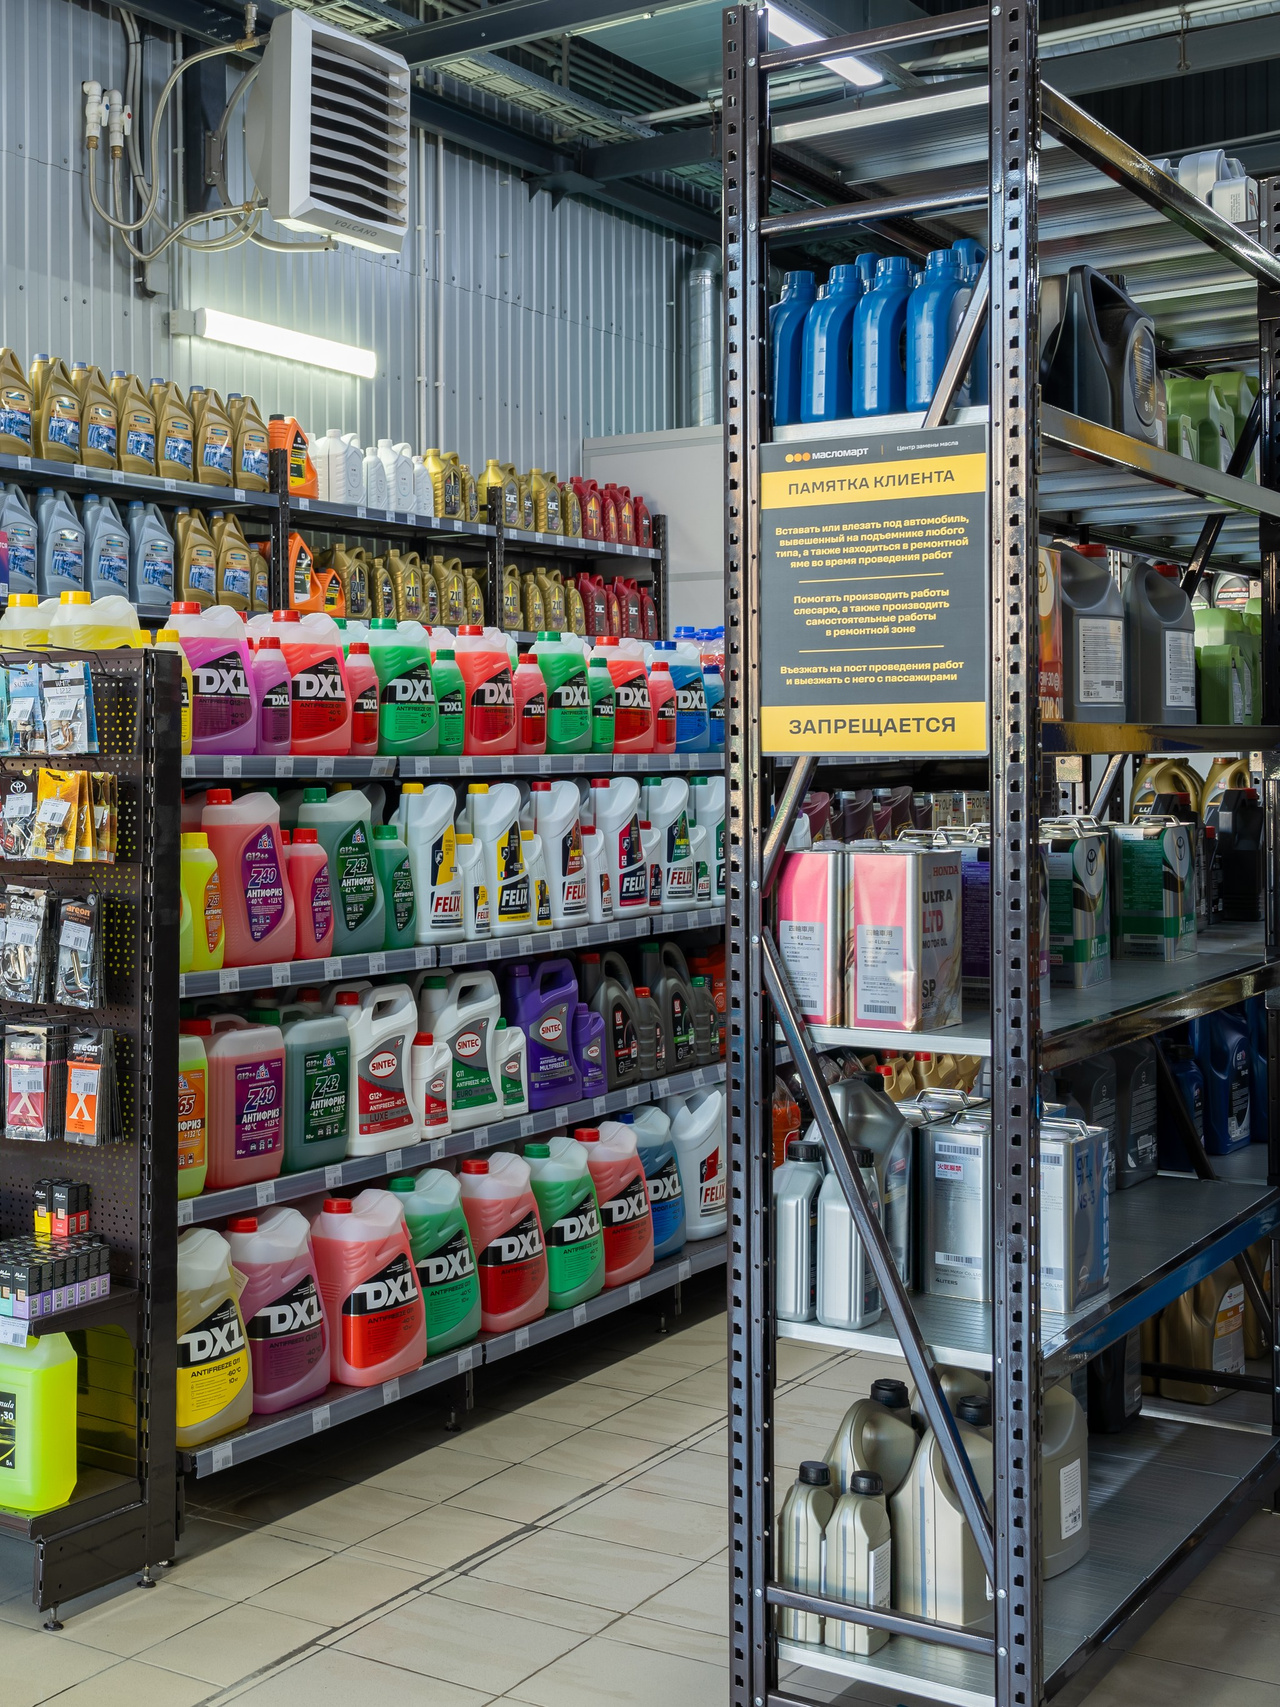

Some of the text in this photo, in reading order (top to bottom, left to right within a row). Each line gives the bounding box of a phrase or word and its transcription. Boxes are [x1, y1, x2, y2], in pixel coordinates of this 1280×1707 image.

[813, 447, 869, 460] масломарт
[897, 444, 915, 452] Центр
[789, 470, 955, 495] ПАМЯТКА КЛИЕНТА
[506, 494, 517, 502] ZIC
[776, 527, 820, 535] Вставать
[843, 522, 881, 531] влезать
[884, 520, 902, 529] под
[904, 515, 969, 525] автомобиль,
[780, 535, 845, 545] вывешенный
[861, 530, 924, 541] подъемнике
[925, 527, 964, 537] любого
[811, 547, 841, 555] также
[843, 543, 901, 553] находиться
[910, 537, 968, 550] ремонтной
[825, 558, 856, 567] время
[859, 554, 920, 565] проведения
[922, 551, 952, 561] работ
[794, 589, 949, 603] Помогать производить работы
[595, 605, 604, 613] ZIC
[794, 607, 840, 615] слесарю,
[850, 604, 880, 612] также
[882, 601, 949, 611] производить
[806, 612, 936, 625] самостоятельные работы
[834, 625, 889, 637] ремонтной
[780, 666, 828, 674] Въезжать
[869, 663, 930, 673] проведения
[933, 660, 964, 671] работ
[196, 668, 251, 694] DX1
[296, 674, 345, 698] DX1
[795, 677, 843, 685] выезжать
[885, 673, 957, 683] пассажирами
[394, 679, 435, 701] DX1
[484, 683, 514, 704] DX1
[559, 685, 589, 706] DX1
[619, 687, 651, 707] DX1
[790, 717, 955, 736] ЗАПРЕЩАЕТСЯ
[671, 870, 693, 886] FELIX
[933, 866, 959, 877] HONDA
[341, 876, 374, 887] АНТИФРИЗ
[622, 873, 645, 893] FELIX
[247, 888, 283, 898] АНТИФРИЗ
[501, 886, 528, 906] FELIX
[922, 889, 953, 903] ULTRA
[66, 905, 90, 914] areon
[434, 895, 461, 913] FELIX
[922, 911, 944, 933] LTD
[922, 938, 948, 949] MOTOR OIL
[922, 979, 936, 997] SP
[541, 1022, 562, 1035] SINTEC
[73, 1043, 97, 1054] areon
[457, 1039, 480, 1050] SINTEC
[371, 1058, 395, 1072] SINTEC
[540, 1060, 565, 1072] MULTIFREEZE
[456, 1088, 474, 1099] EURO
[310, 1095, 346, 1111] АНТИФРИЗ
[242, 1108, 280, 1124] АНТИФРИЗ
[369, 1111, 389, 1123] LUXE
[562, 1213, 600, 1242] DX1
[498, 1231, 543, 1262] DX1
[426, 1251, 475, 1283] DX1
[364, 1272, 418, 1311] DX1
[430, 1284, 463, 1297] ANTIFREEZE
[266, 1297, 323, 1334] DX1
[187, 1319, 244, 1362] DX1
[191, 1360, 233, 1378] ANTIFREEZE
[0, 1412, 14, 1421] -30
